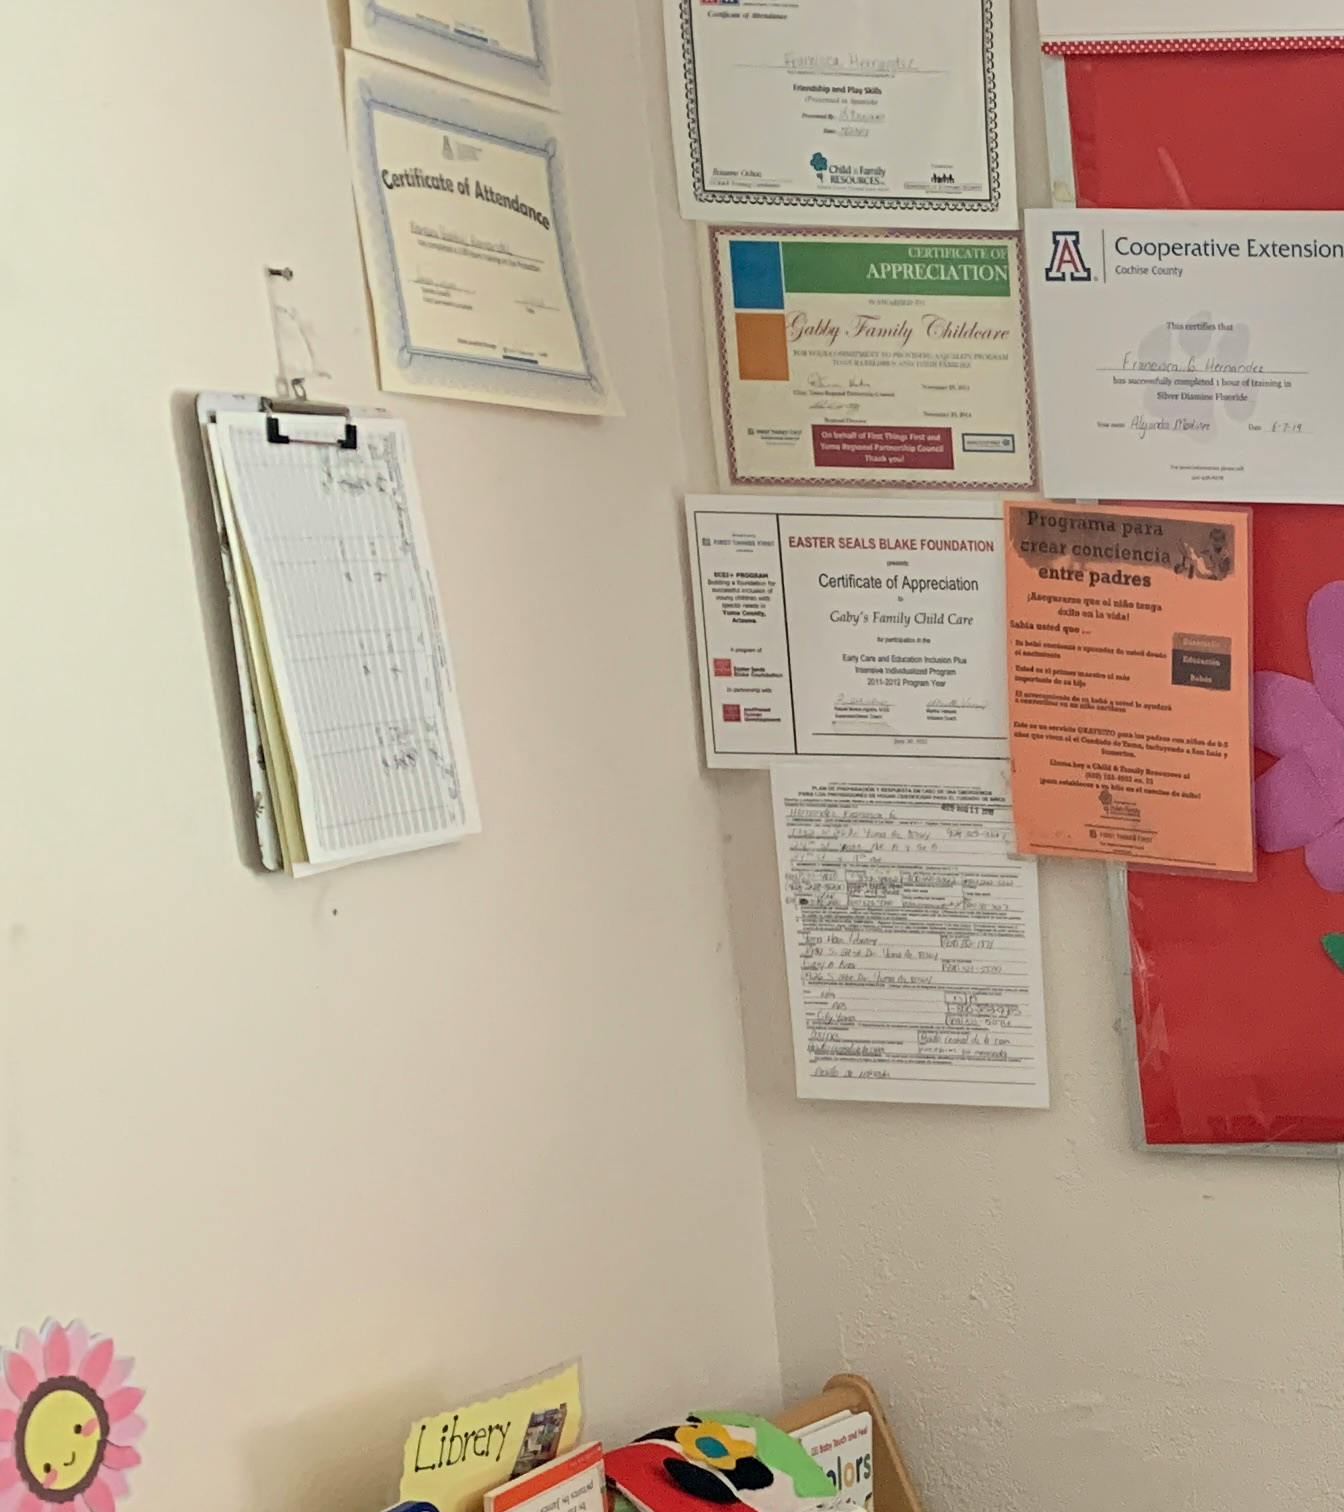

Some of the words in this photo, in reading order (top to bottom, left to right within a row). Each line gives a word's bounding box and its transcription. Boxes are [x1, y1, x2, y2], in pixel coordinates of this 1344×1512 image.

[793, 84, 830, 94] Friendship
[832, 85, 846, 94] and
[847, 85, 863, 95] Play
[864, 86, 882, 95] Skills
[829, 165, 852, 174] Child
[859, 166, 886, 177] Family
[830, 174, 880, 185] RESOURCES
[381, 166, 454, 192] Certificate
[458, 177, 470, 196] of
[475, 180, 550, 230] Attendance
[908, 248, 988, 260] CERTIFICATE
[990, 249, 1007, 260] OF
[1114, 236, 1240, 261] Cooperative
[1247, 238, 1344, 258] Extension
[866, 263, 1007, 281] APPRECIATION
[1115, 265, 1149, 276] Cochise
[1151, 265, 1183, 278] County
[787, 312, 840, 346] Gabby
[846, 314, 913, 346] Family
[921, 313, 1010, 341] Childcare
[1167, 322, 1183, 330] This
[1185, 322, 1216, 331] certifies
[1217, 323, 1233, 331] that
[1174, 377, 1214, 387] completed
[1222, 378, 1240, 386] hour
[1251, 379, 1282, 389] training
[1156, 392, 1178, 400] Silver
[1215, 393, 1248, 401] Fluoride
[1027, 510, 1116, 533] Programa
[1121, 521, 1164, 537] para
[788, 536, 835, 549] EASTER
[839, 537, 876, 549] SEALS
[879, 539, 917, 551] BLAKE
[920, 539, 994, 552] FOUNDATION
[1020, 540, 1067, 555] crear
[1072, 543, 1171, 563] conciencia
[818, 573, 882, 589] Certificate
[886, 575, 899, 589] of
[902, 575, 979, 593] Appreciation
[1038, 566, 1085, 581] entre
[1089, 567, 1152, 587] padres
[830, 610, 869, 626] Gaby's
[872, 611, 911, 628] Family
[914, 612, 944, 625] Child
[948, 613, 974, 626] Care
[860, 655, 876, 663] Care
[878, 655, 890, 663] and
[891, 655, 922, 663] Education
[924, 656, 951, 664] Inclusion
[902, 679, 930, 688] Program
[414, 1415, 511, 1474] Librery
